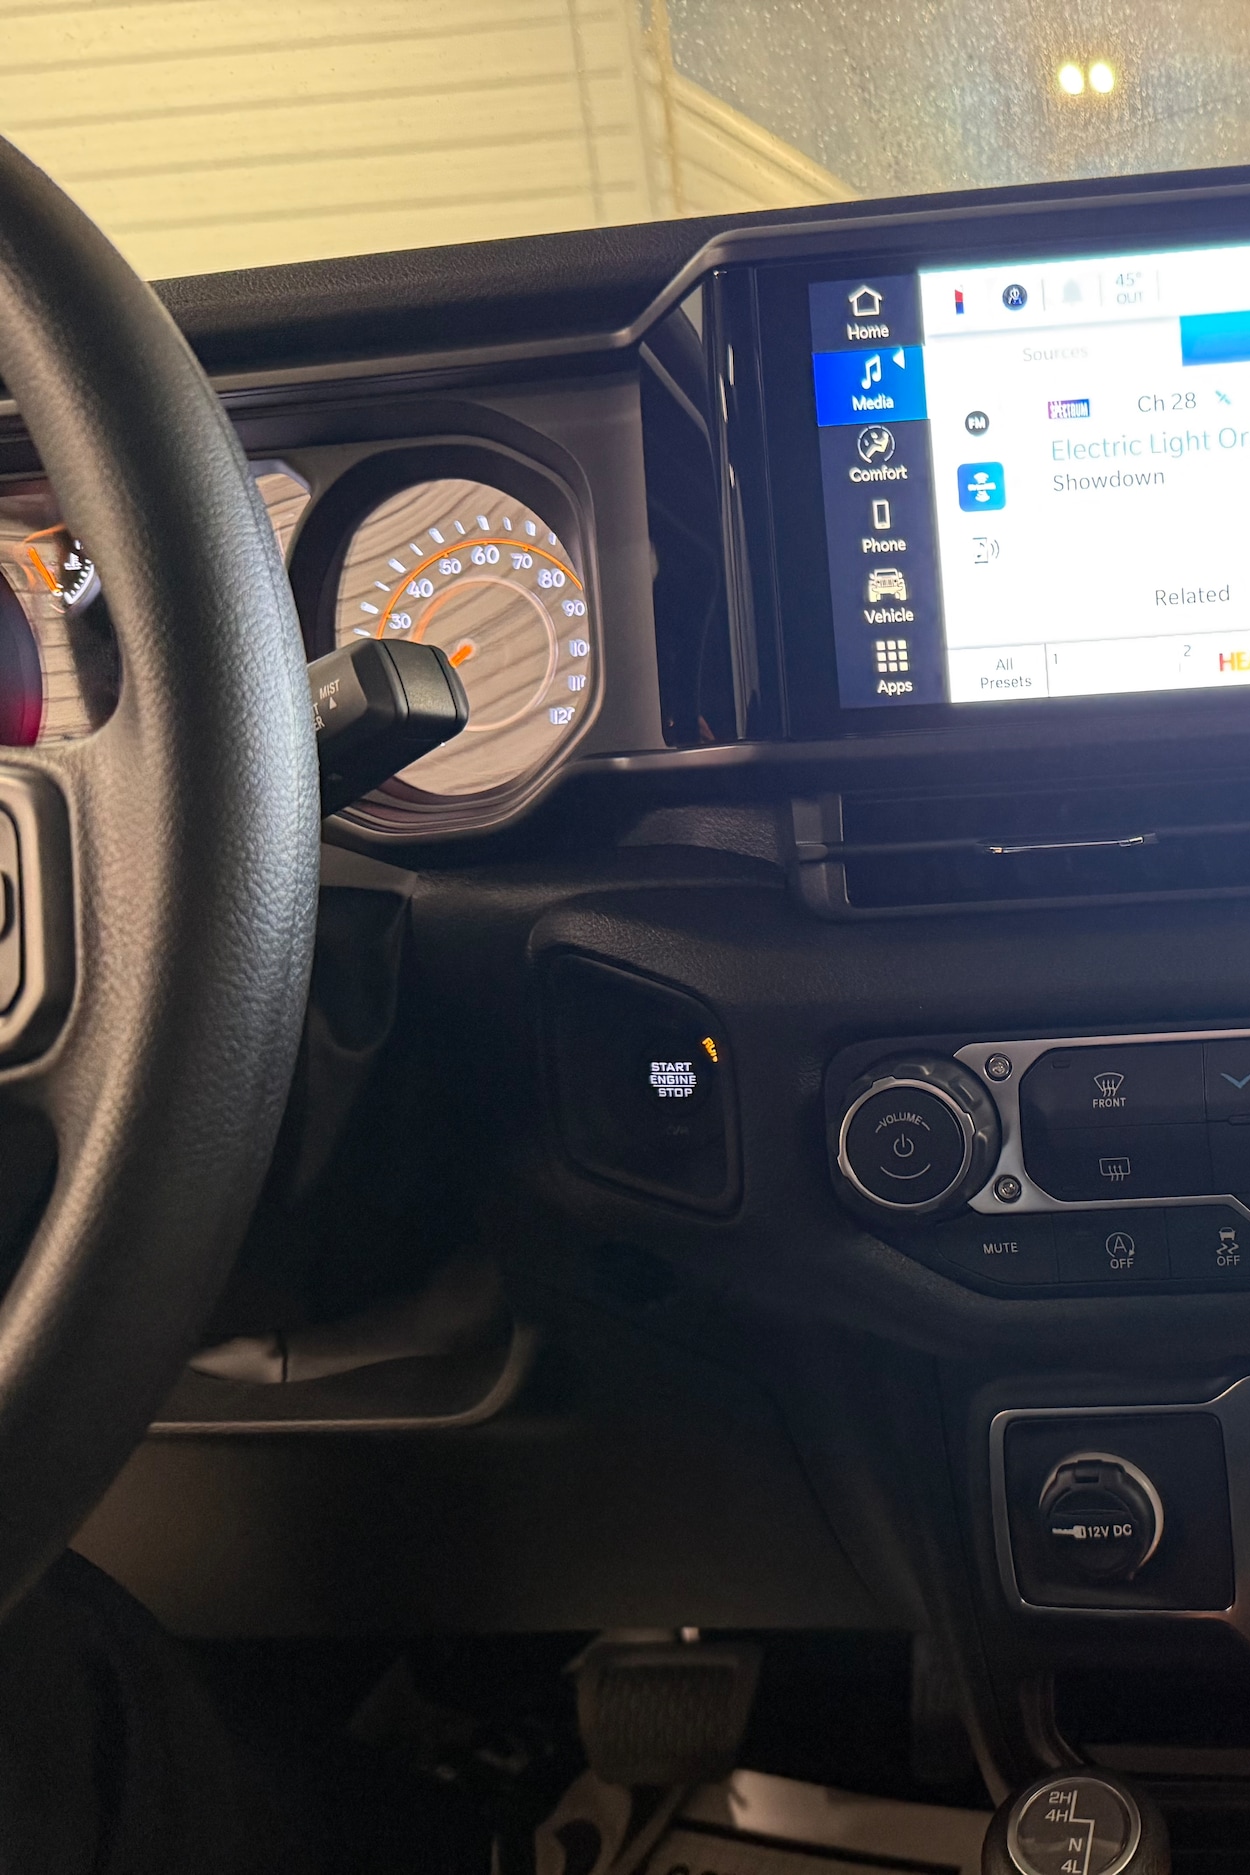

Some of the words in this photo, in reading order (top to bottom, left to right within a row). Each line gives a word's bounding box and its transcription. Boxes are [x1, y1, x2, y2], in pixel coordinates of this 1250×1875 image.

[1116, 291, 1143, 305] OUT
[847, 323, 890, 341] Home
[1022, 345, 1088, 362] Sources
[852, 394, 895, 411] Media
[1137, 394, 1165, 413] Ch
[1171, 391, 1197, 411] 28
[967, 416, 986, 430] FM
[1051, 433, 1143, 462] Electric
[1149, 430, 1212, 460] Light
[849, 465, 908, 483] Comfort
[1052, 468, 1165, 493] Showdown
[862, 536, 907, 554] Phone
[470, 544, 500, 565] 60
[510, 552, 533, 570] 70
[438, 558, 462, 576] 50
[537, 568, 566, 588] 80
[406, 578, 434, 599] 40
[1155, 584, 1231, 608] Related
[562, 600, 586, 617] 90
[863, 607, 914, 624] Vehicle
[389, 613, 412, 630] 30
[568, 639, 590, 657] 10
[1183, 644, 1191, 657] 2
[995, 656, 1014, 672] All
[320, 678, 340, 700] MIST
[876, 679, 913, 696] Apps
[980, 673, 1033, 690] Presets
[650, 1061, 693, 1072] START
[649, 1075, 697, 1085] ENGINE
[658, 1087, 693, 1098] STOP
[1092, 1096, 1126, 1109] FRONT
[878, 1112, 923, 1130] VOLUME
[982, 1241, 1019, 1255] MUTE
[1110, 1256, 1134, 1270] OFF
[1216, 1254, 1241, 1268] OFF
[1087, 1525, 1110, 1538] 12V
[1112, 1523, 1132, 1538] DC
[1048, 1791, 1072, 1804] 2H
[1045, 1809, 1069, 1823] 4H
[1068, 1837, 1083, 1852] N
[1060, 1859, 1082, 1874] 4L
